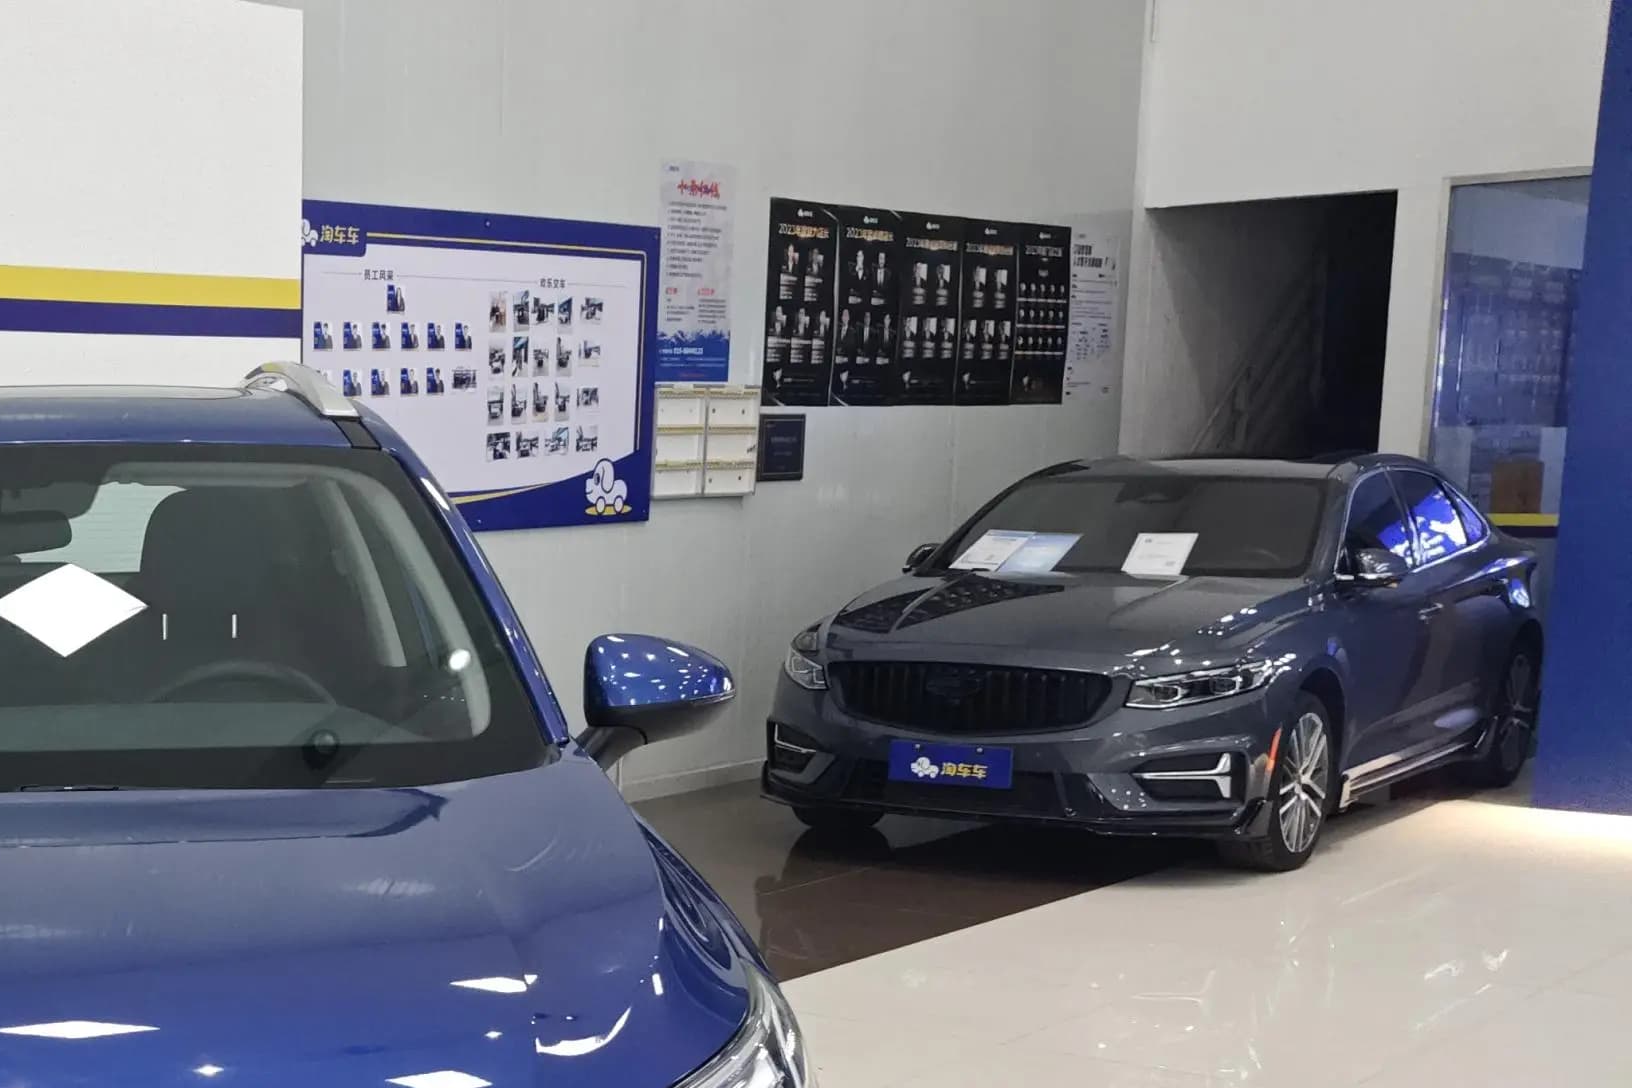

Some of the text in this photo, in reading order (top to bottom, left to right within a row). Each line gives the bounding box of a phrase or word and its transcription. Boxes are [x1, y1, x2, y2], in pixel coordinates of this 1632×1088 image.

[319, 224, 360, 245] 淘车车
[364, 269, 394, 281] 员工风采
[940, 761, 989, 780] 淘车车
